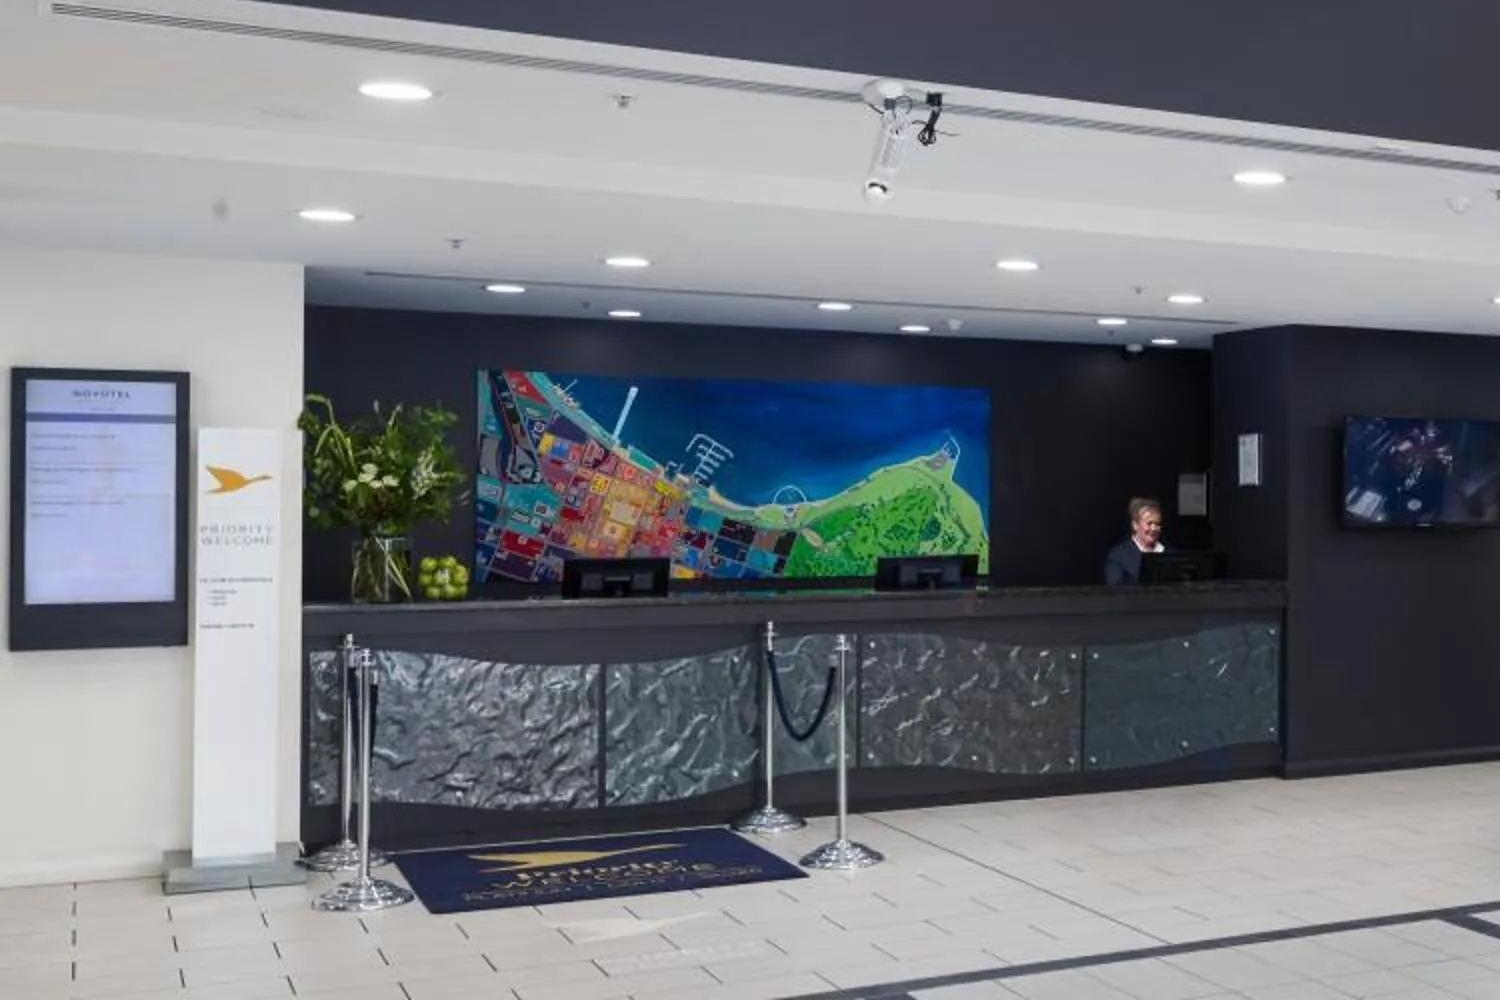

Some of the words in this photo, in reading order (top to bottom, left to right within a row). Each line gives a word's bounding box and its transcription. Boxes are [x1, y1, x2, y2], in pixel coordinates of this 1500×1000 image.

[71, 389, 132, 399] NOVOTEL
[200, 525, 274, 535] PRIORITY
[201, 535, 274, 546] WELCOME
